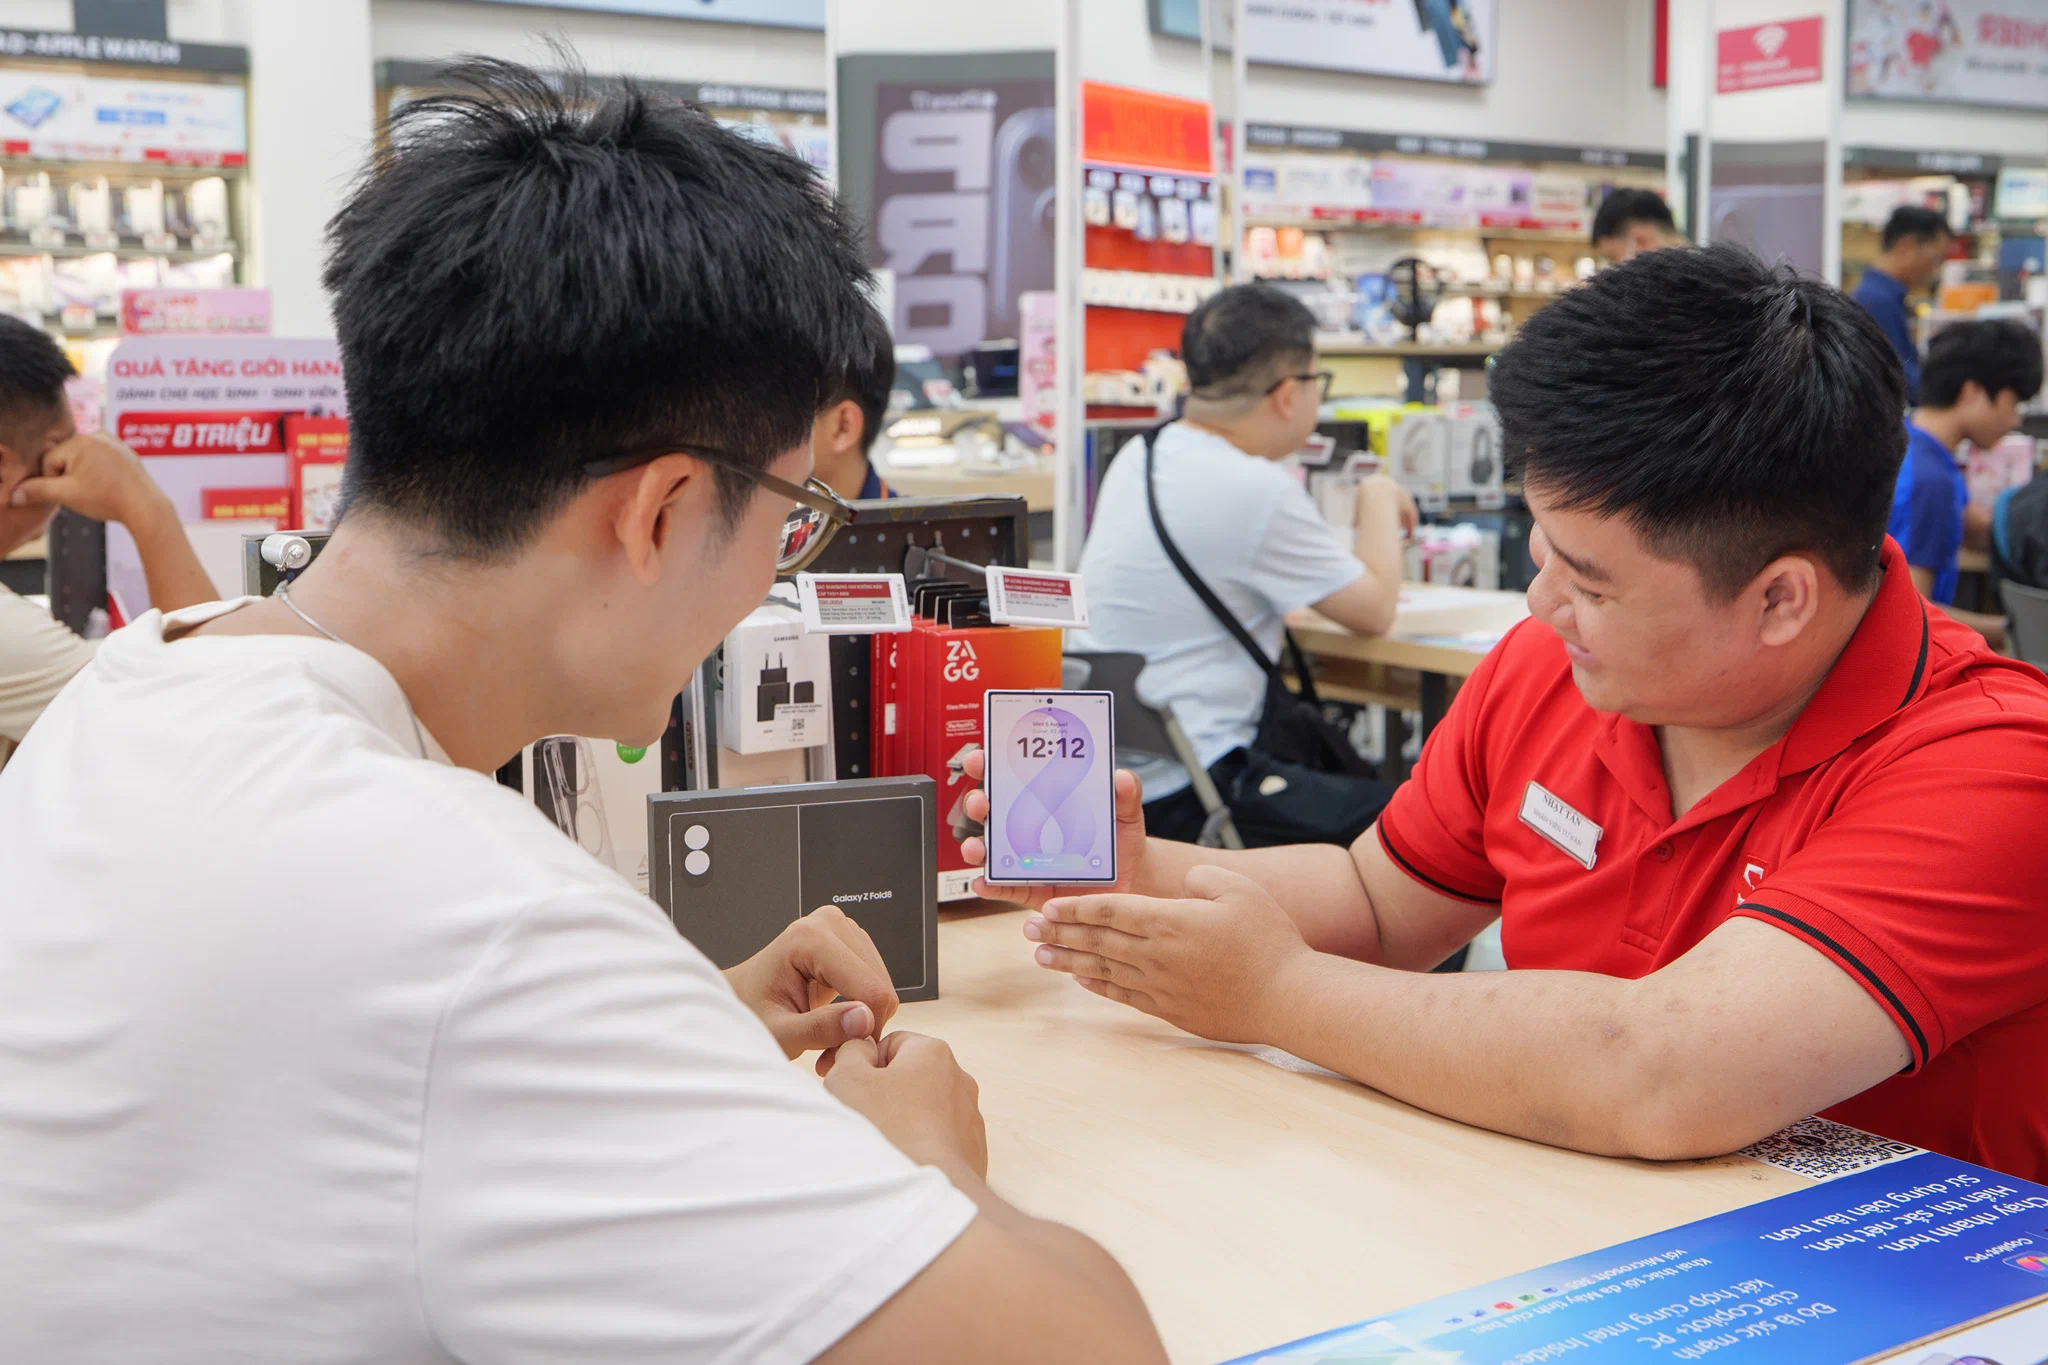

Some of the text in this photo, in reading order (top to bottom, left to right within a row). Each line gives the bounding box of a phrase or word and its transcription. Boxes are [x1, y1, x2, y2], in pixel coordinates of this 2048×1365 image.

[1017, 737, 1085, 758] 12:12
[832, 890, 893, 903] Galaxy Z Fold8
[1759, 1173, 1981, 1242] Sử dụng bền lâu hơn.
[1803, 1185, 2018, 1253] Hiển thị sắc nét hơn.
[1935, 1211, 2000, 1238] nhanh
[1878, 1229, 1941, 1252] hơn.
[1598, 1254, 1666, 1283] Microsoft
[1675, 1257, 1713, 1272] Khai
[1688, 1288, 1741, 1308] hợp
[1730, 1278, 1775, 1295] kết
[1628, 1303, 1690, 1326] cùng
[1636, 1290, 1800, 1350] của Copilot+ PC
[1582, 1320, 1638, 1344] Intel
[1672, 1302, 1838, 1360] Đó là sức mạnh
